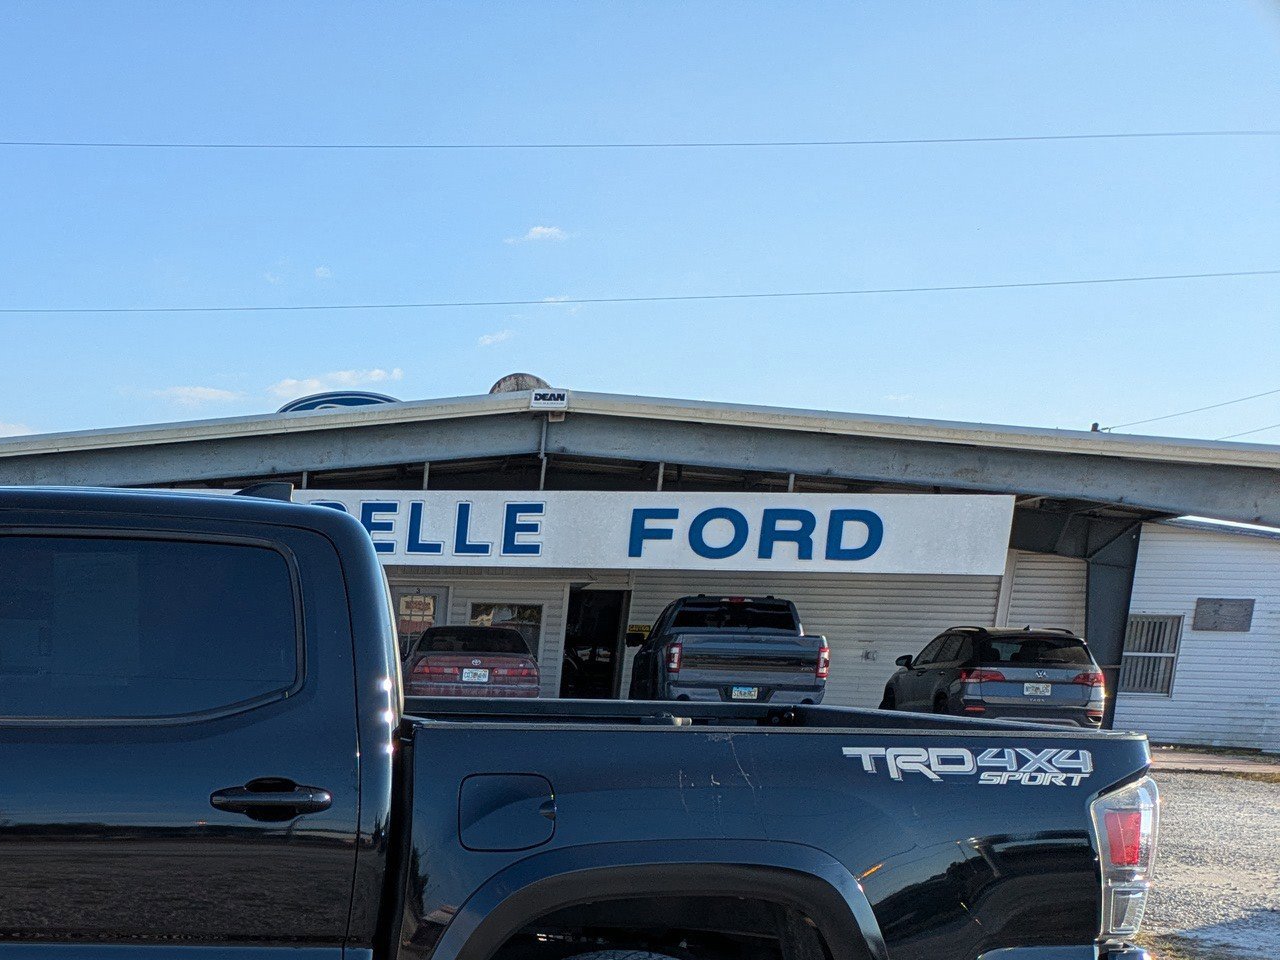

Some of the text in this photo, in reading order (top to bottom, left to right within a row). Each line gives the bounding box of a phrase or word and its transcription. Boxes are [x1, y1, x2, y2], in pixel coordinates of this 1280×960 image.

[534, 393, 566, 401] DEAN
[310, 500, 883, 560] ELLE FORD
[842, 747, 977, 781] TRD
[978, 771, 1090, 787] SPORT
